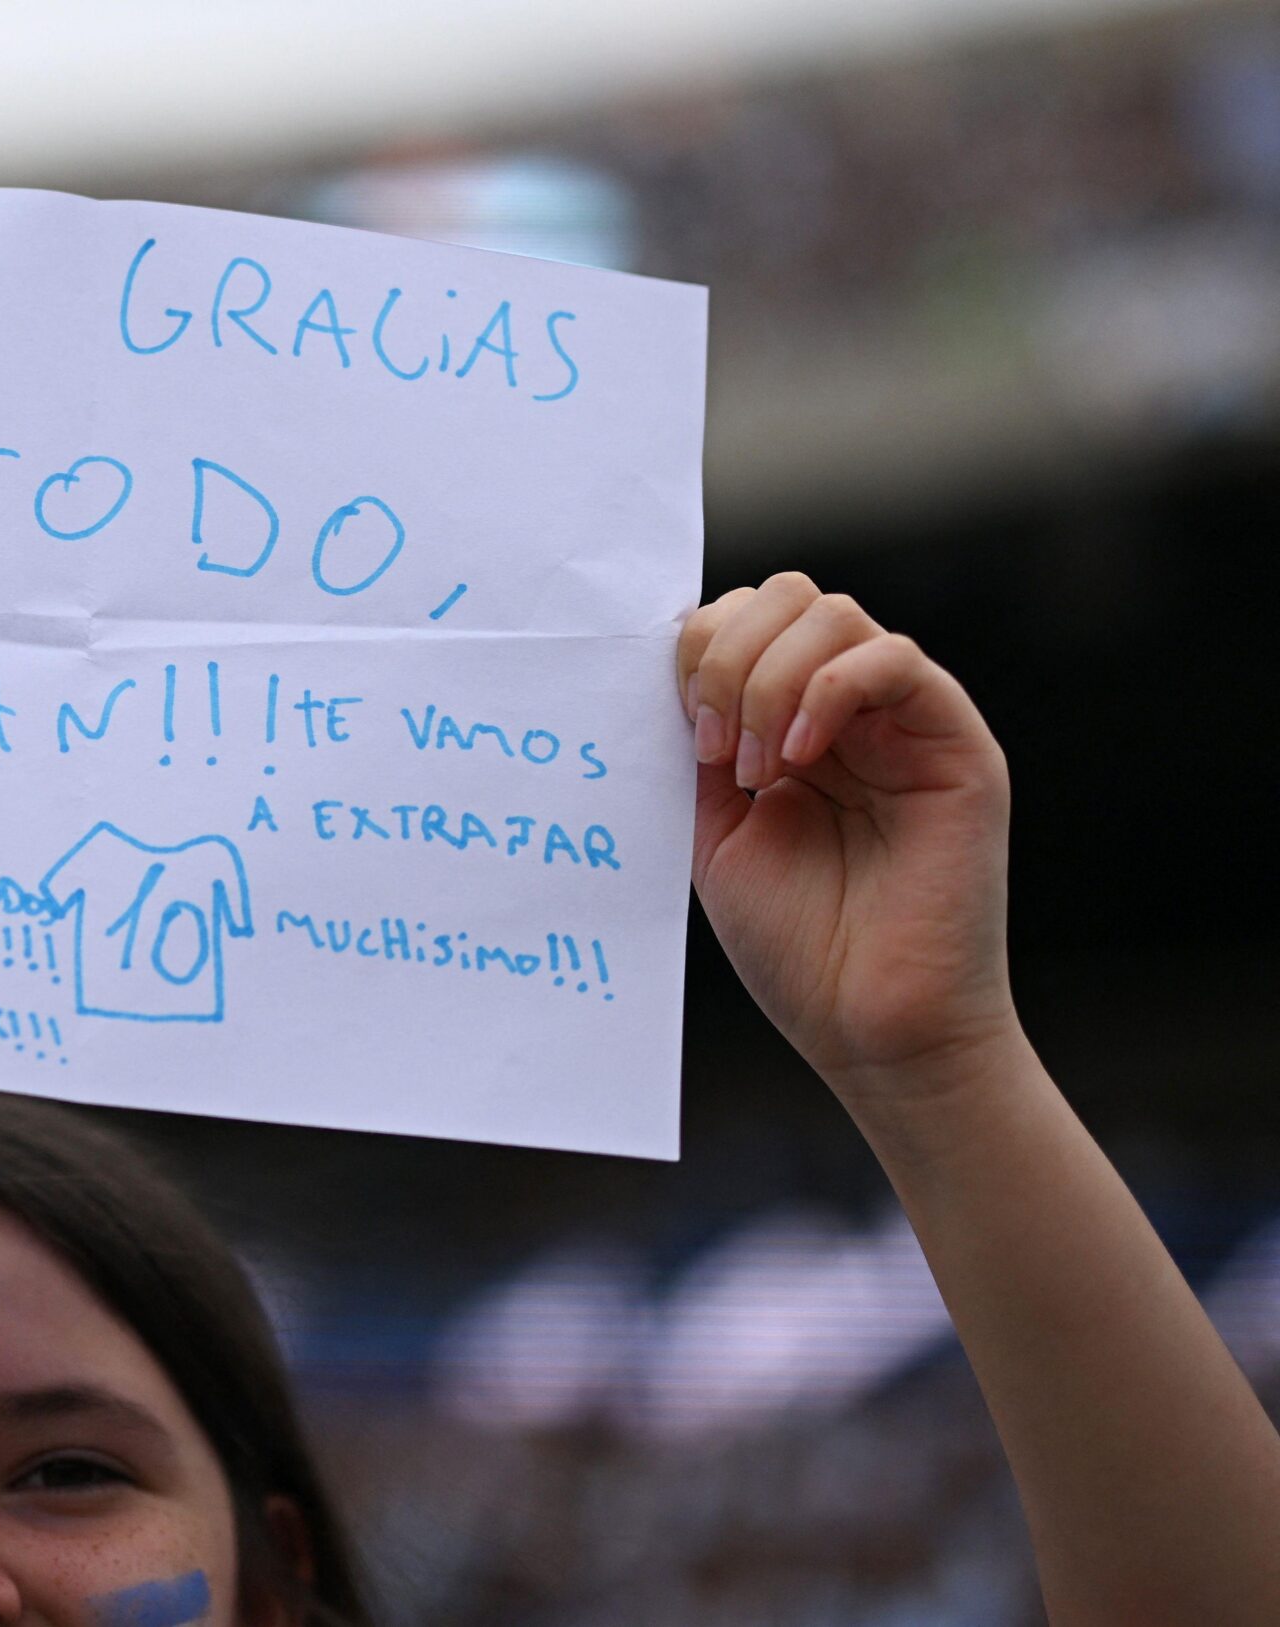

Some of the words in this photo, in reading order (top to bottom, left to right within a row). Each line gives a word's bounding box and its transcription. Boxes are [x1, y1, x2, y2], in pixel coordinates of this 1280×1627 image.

[399, 703, 609, 781] VAMOS
[246, 795, 280, 833] A
[104, 861, 210, 986] 10
